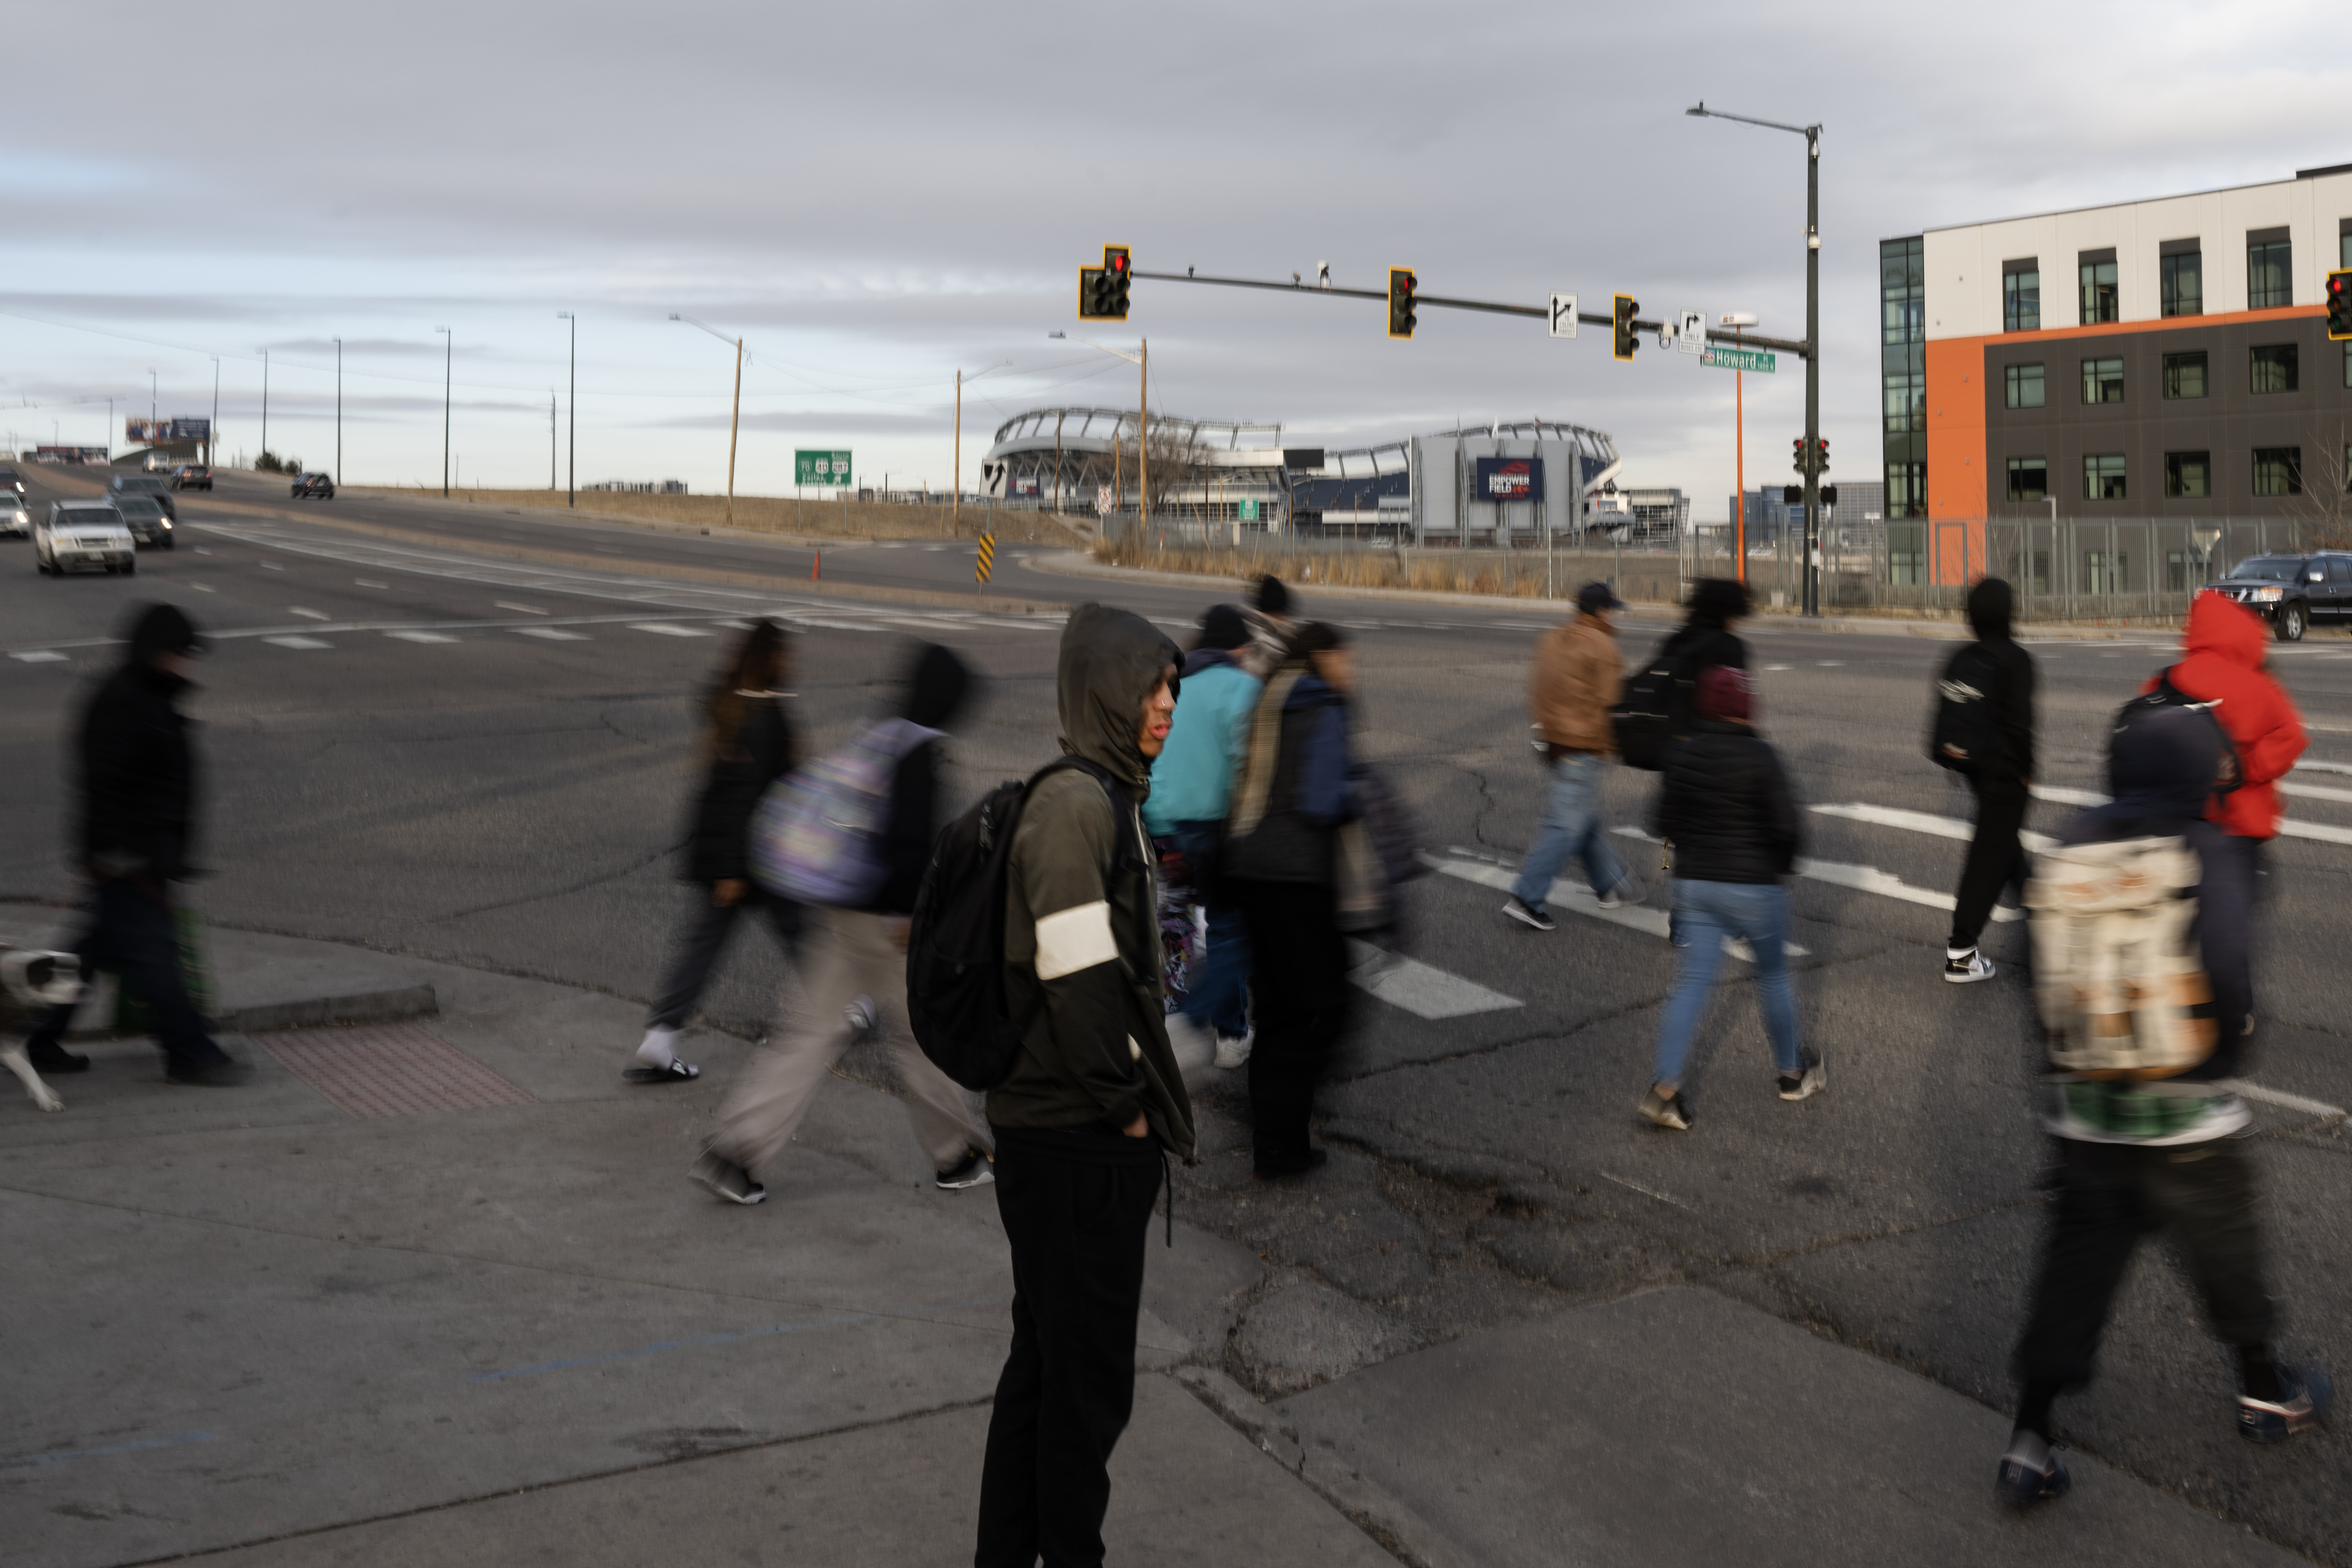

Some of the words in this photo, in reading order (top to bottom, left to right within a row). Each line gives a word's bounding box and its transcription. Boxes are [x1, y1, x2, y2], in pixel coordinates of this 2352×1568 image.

[1559, 320, 1574, 329] COLFAX
[1558, 328, 1575, 336] VIADUCT
[1684, 332, 1700, 342] ONLY
[1681, 342, 1694, 352] BUSES
[1716, 348, 1756, 370] Howard
[1757, 360, 1769, 371] 1400
[832, 450, 849, 460] South
[801, 459, 810, 472] 70
[817, 459, 828, 472] 40
[833, 460, 848, 472] 287
[802, 472, 824, 482] Colfax
[1489, 473, 1530, 486] EMPOWER
[801, 478, 827, 487] Avenue
[1489, 484, 1512, 493] FIELD
